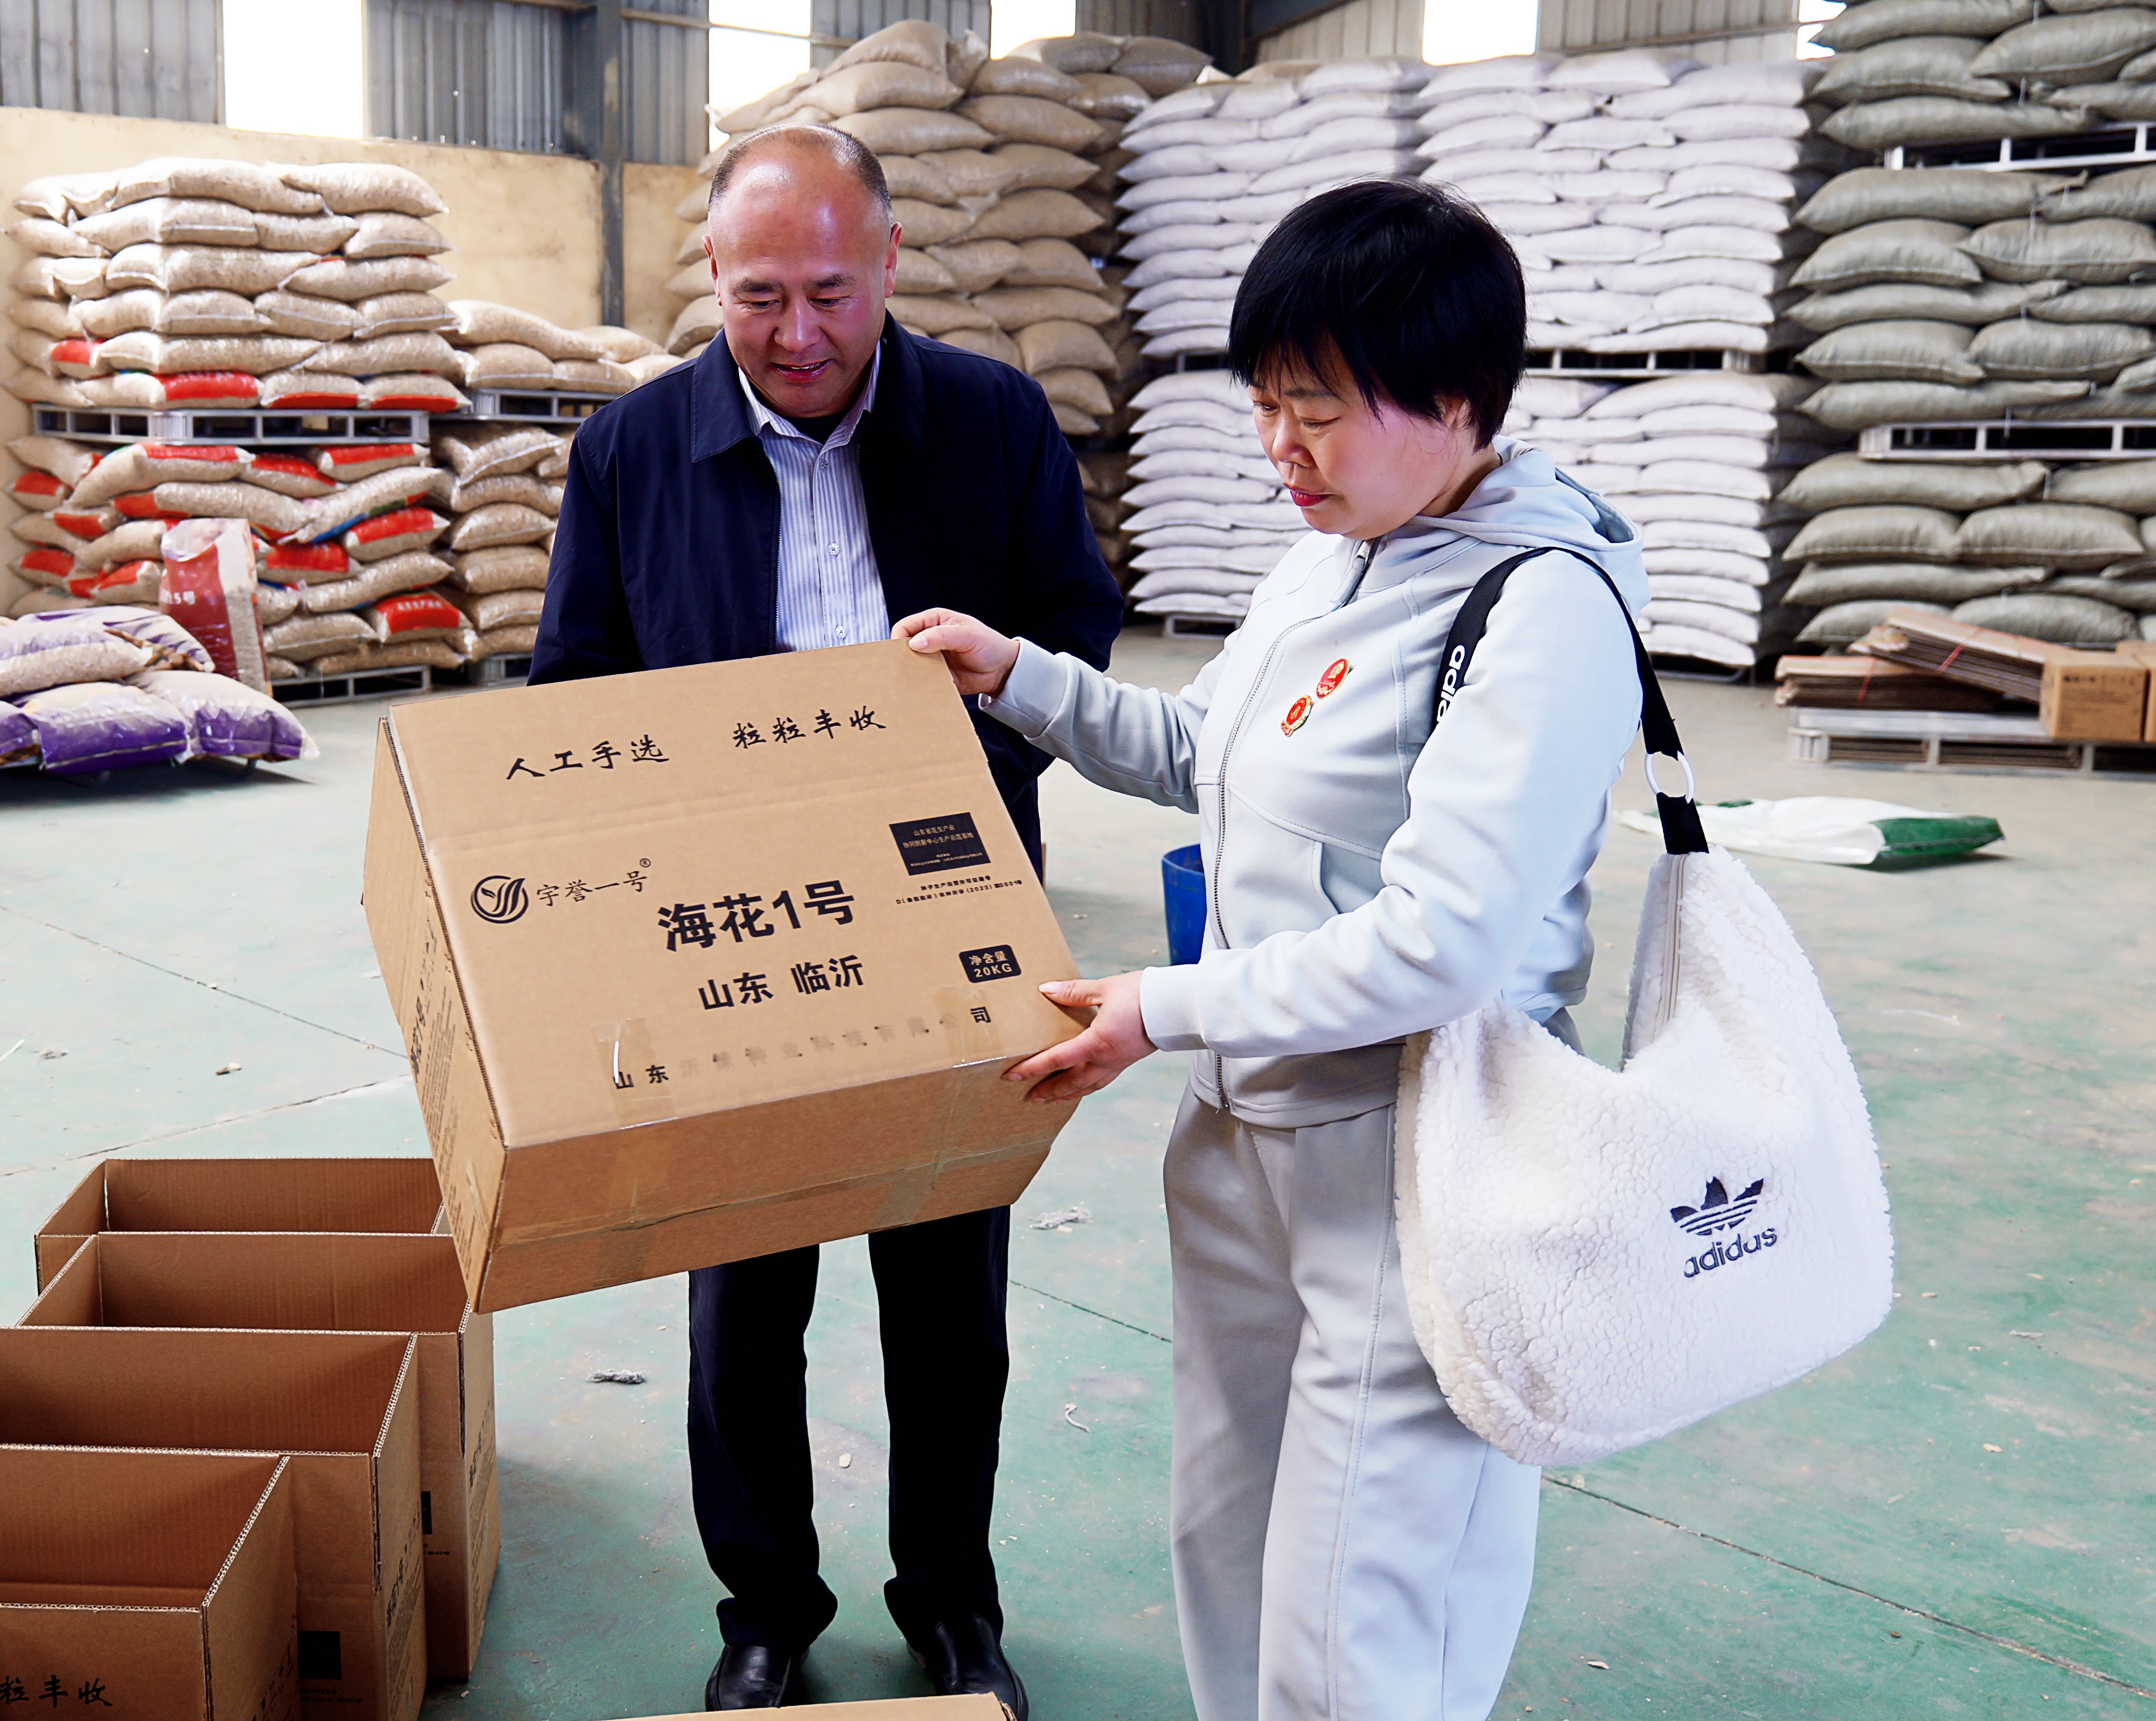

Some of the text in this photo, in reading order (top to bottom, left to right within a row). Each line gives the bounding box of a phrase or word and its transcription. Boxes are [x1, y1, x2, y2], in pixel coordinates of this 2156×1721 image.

[505, 705, 887, 781] 人工手选 粒粒丰收
[536, 870, 648, 906] 宇誉一号
[657, 880, 855, 952] 海花1号
[698, 955, 864, 1010] 山东 临沂
[969, 951, 1008, 965] 净含量
[973, 963, 1012, 977] 20KG
[1684, 1228, 1777, 1278] adidas
